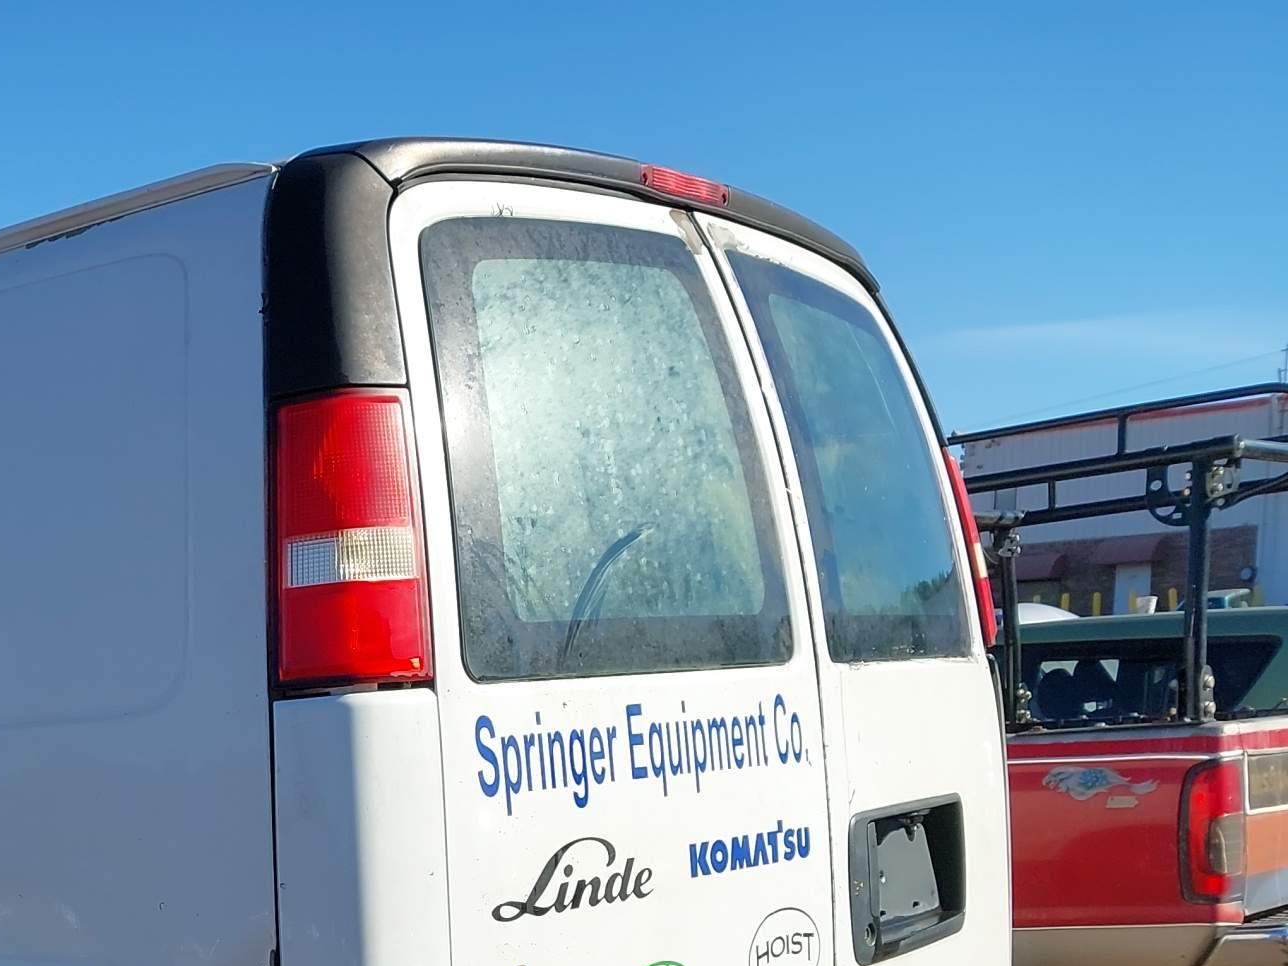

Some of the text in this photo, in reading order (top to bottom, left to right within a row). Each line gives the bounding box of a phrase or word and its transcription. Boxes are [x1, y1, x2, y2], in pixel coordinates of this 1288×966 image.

[474, 711, 617, 817] Springer
[625, 700, 769, 797] Equipment
[492, 837, 654, 922] Linde
[688, 819, 811, 878] KOMATSU
